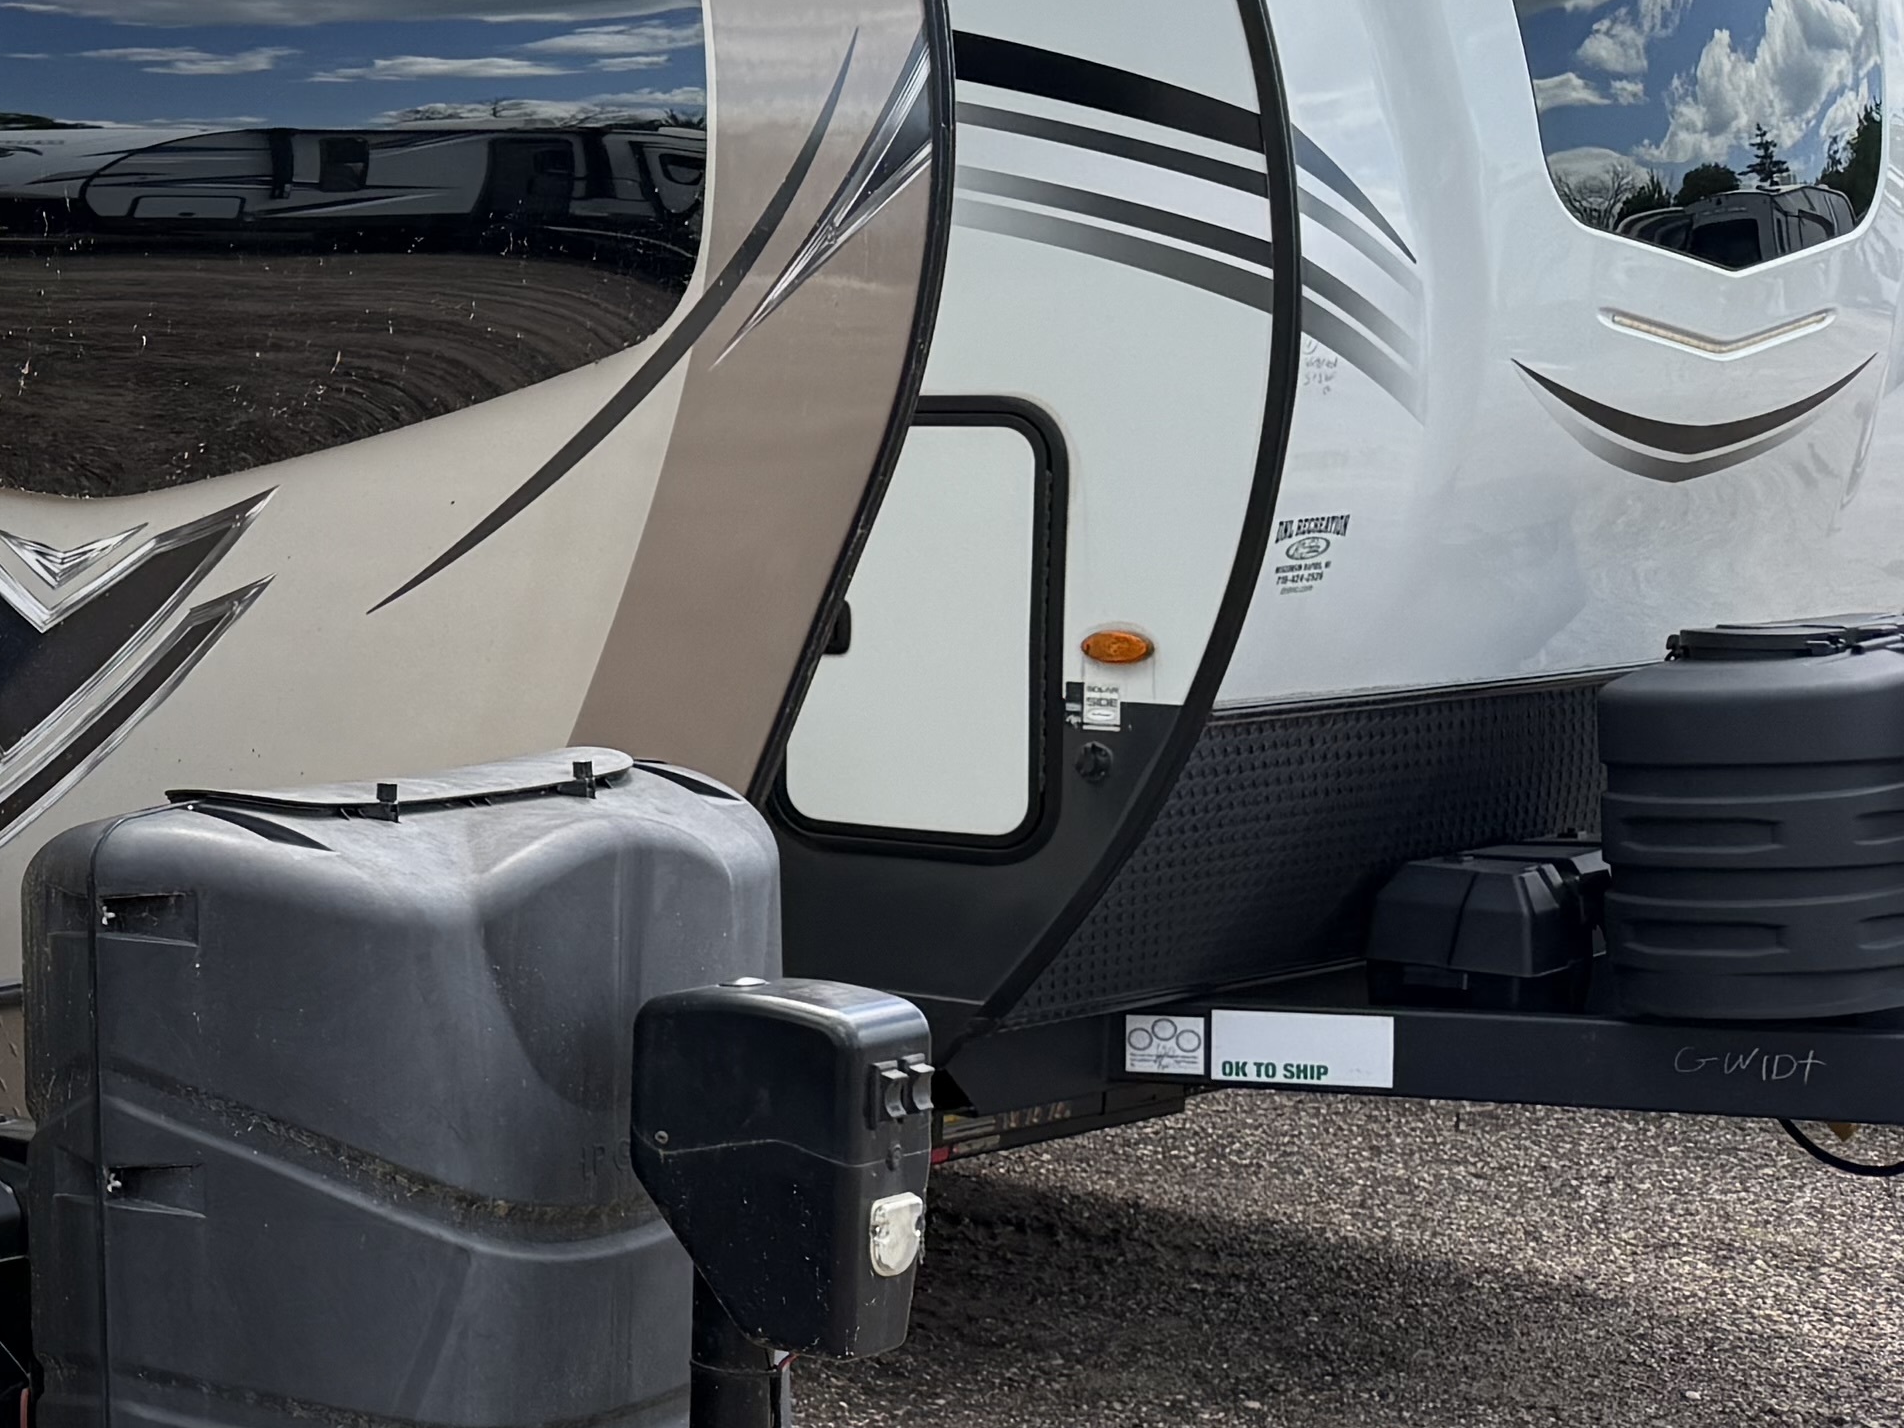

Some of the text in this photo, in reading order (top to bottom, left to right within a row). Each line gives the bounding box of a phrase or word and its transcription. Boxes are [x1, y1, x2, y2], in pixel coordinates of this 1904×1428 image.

[1086, 697, 1118, 707] SIDE
[1221, 1060, 1329, 1081] OK TO SHIP
